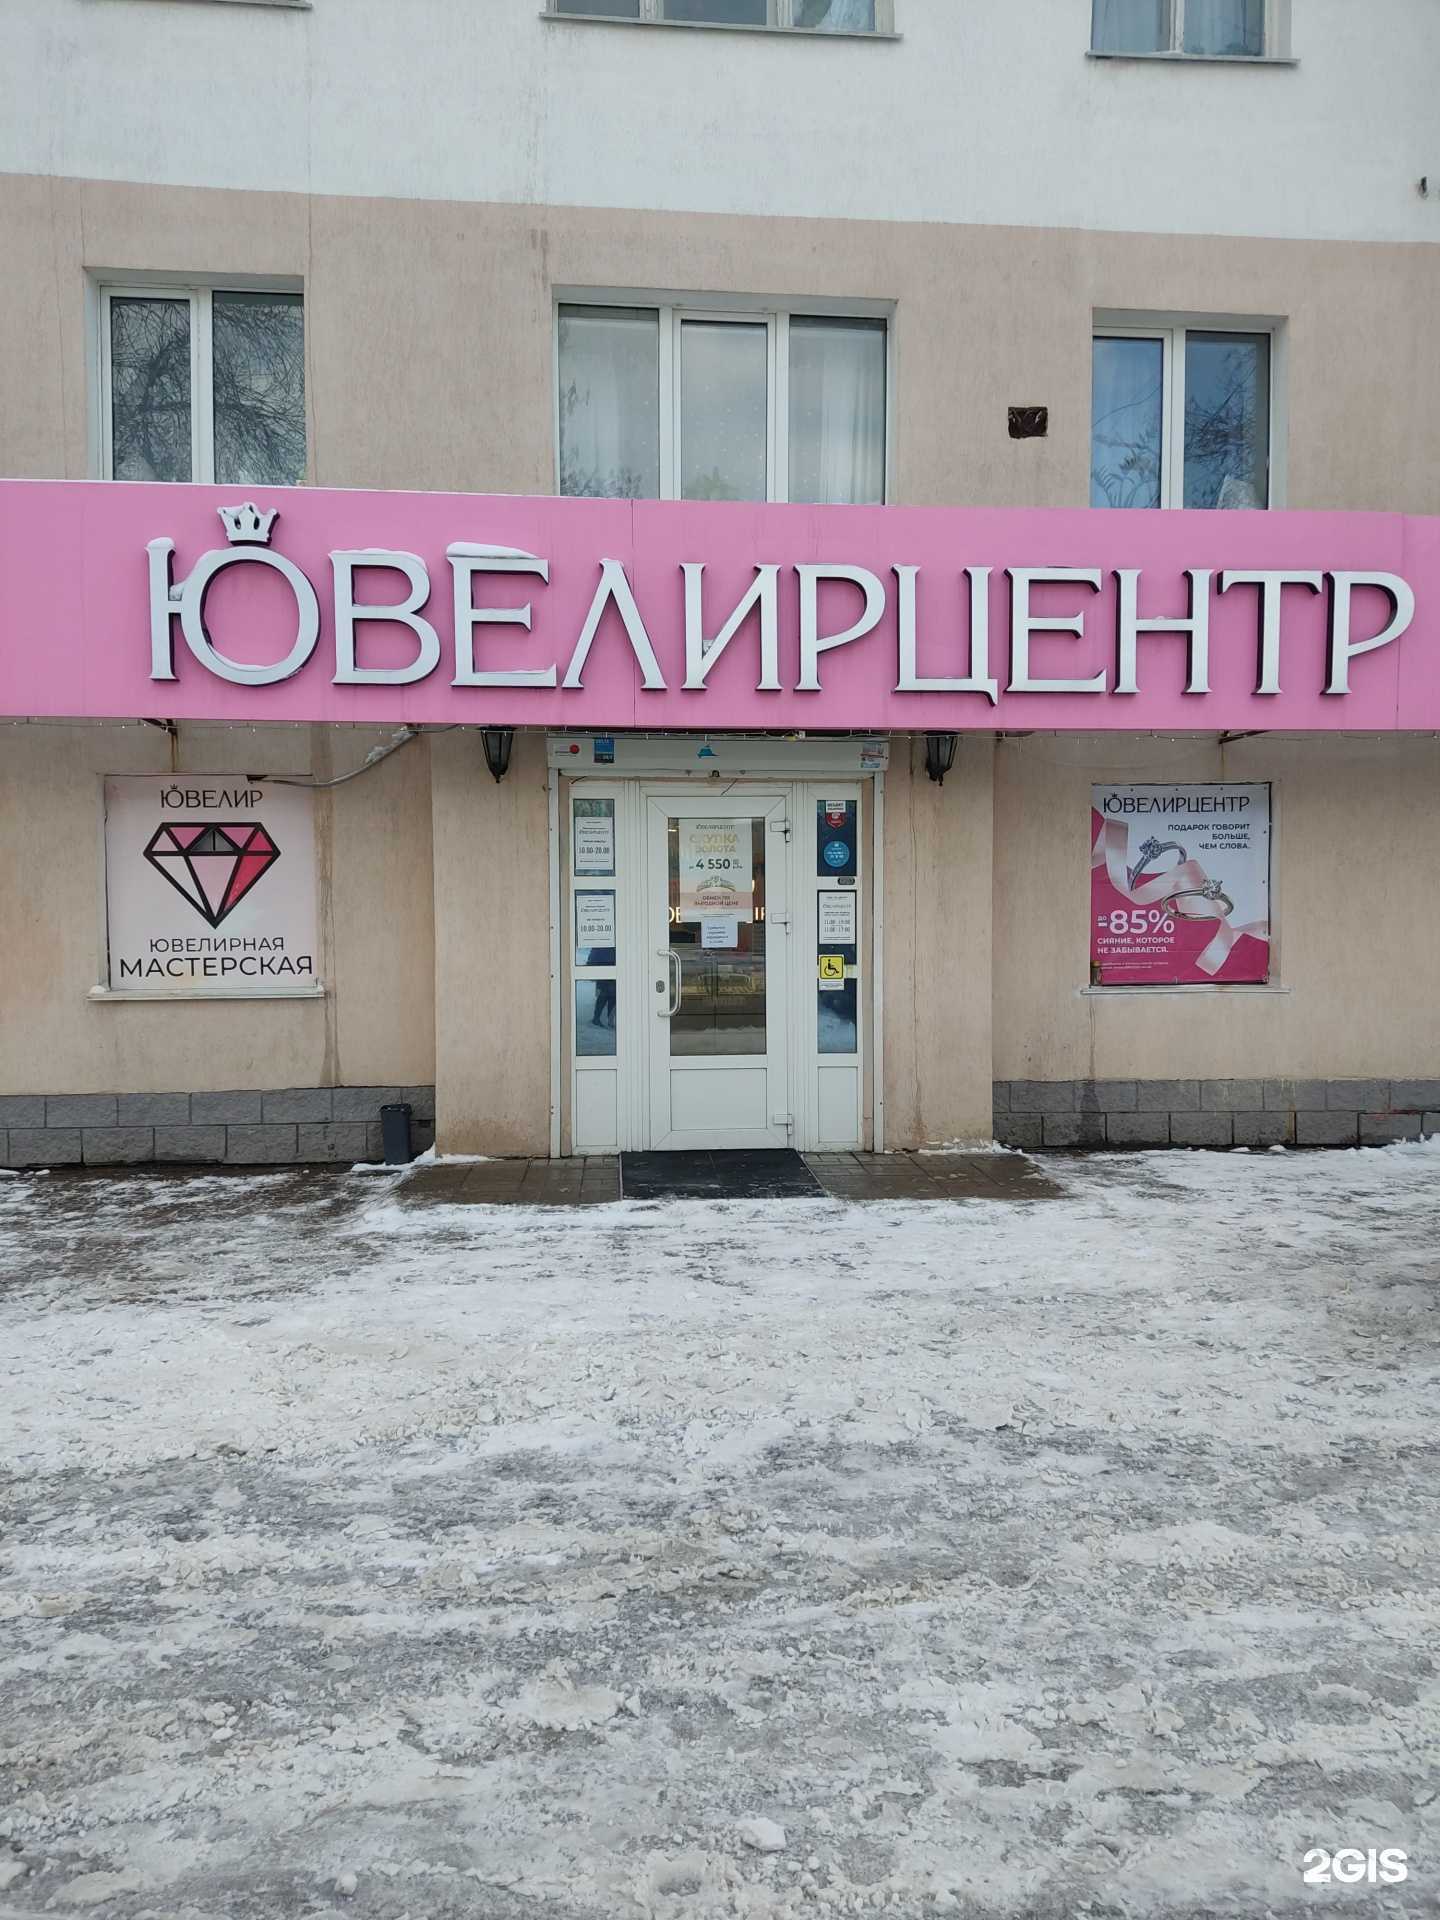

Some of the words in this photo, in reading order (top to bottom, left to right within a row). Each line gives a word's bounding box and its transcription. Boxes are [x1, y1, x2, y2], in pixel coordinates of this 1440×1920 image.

[147, 532, 1417, 706] ЮВЕЛИРЦЕНТР
[160, 787, 264, 809] ЮВЕЛИР
[1103, 795, 1250, 814] ЮВЕЛИРЦЕНТР
[1212, 823, 1251, 831] ГОВОРИТ
[1199, 842, 1218, 850] ЧЕМ
[708, 858, 731, 870] 550
[1098, 909, 1175, 934] -85%
[150, 936, 284, 953] ЮВЕЛИРНАЯ
[1136, 936, 1175, 945] КОТОРОЕ
[1097, 947, 1109, 955] НЕ
[119, 955, 313, 978] МАСТЕРСКАЯ
